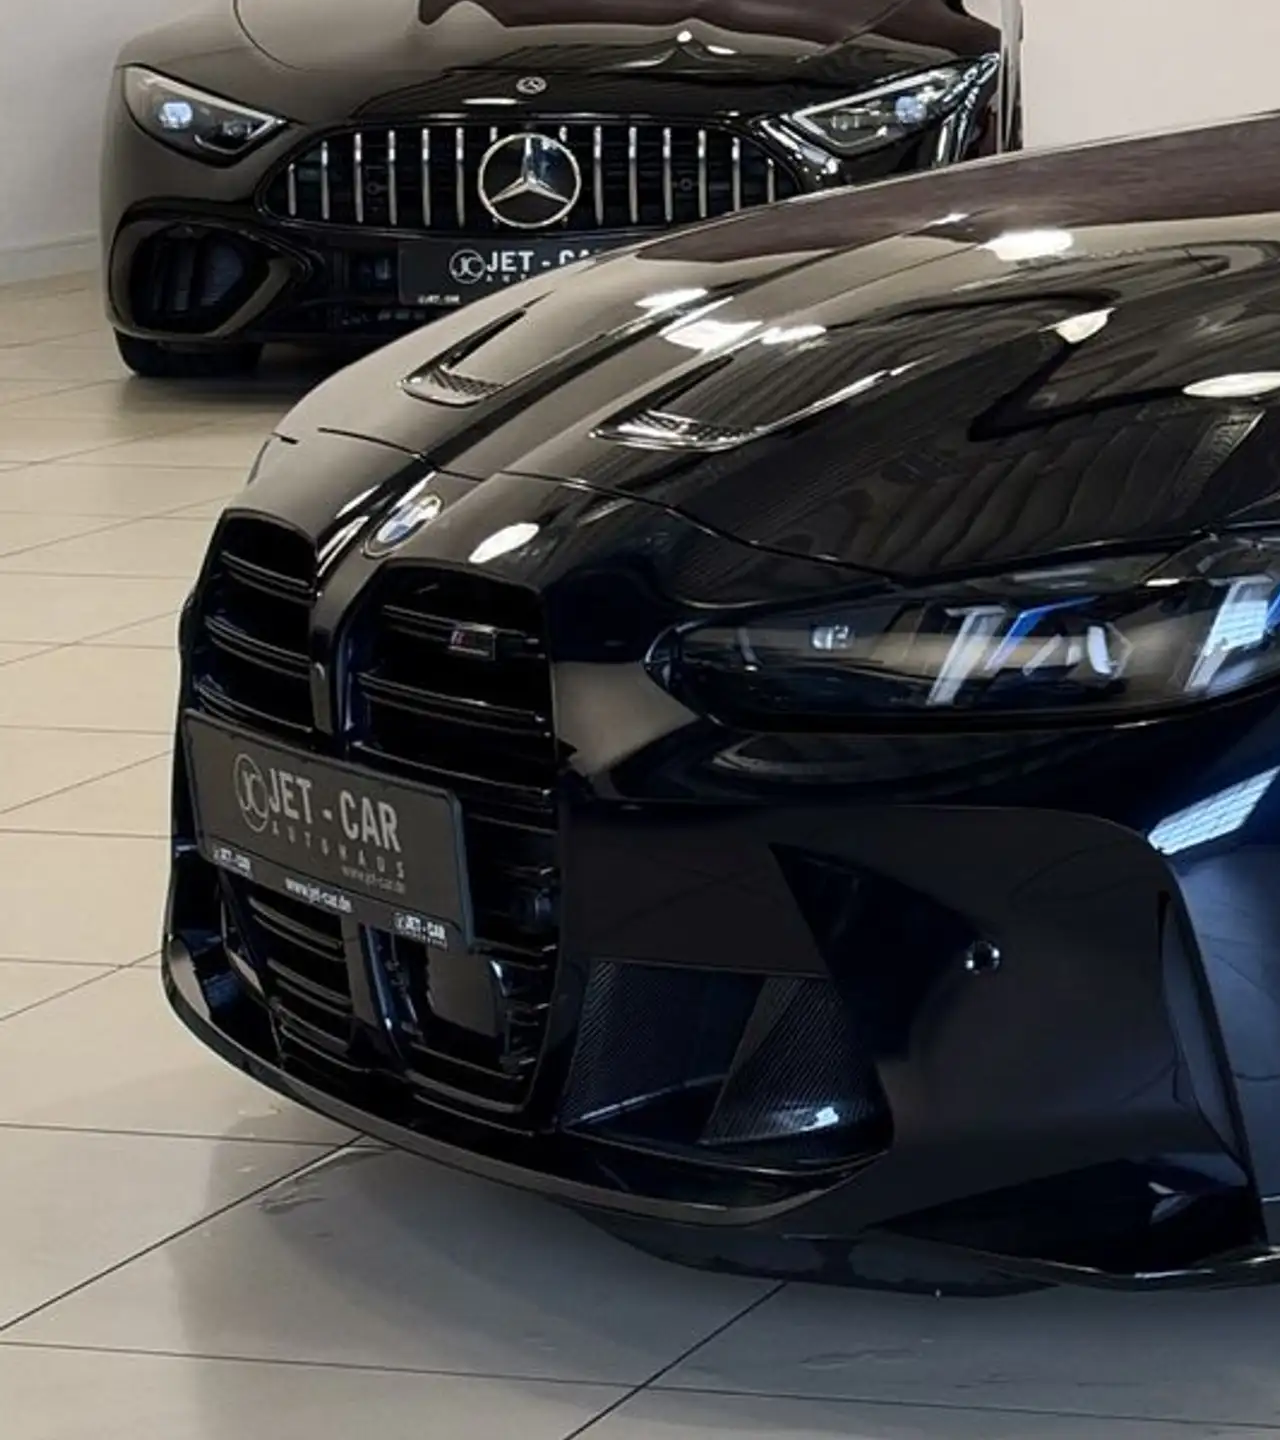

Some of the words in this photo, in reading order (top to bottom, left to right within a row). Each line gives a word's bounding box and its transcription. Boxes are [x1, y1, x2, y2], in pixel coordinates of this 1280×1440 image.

[486, 250, 535, 273] JET
[267, 767, 313, 825] JET
[339, 789, 402, 853] CAR
